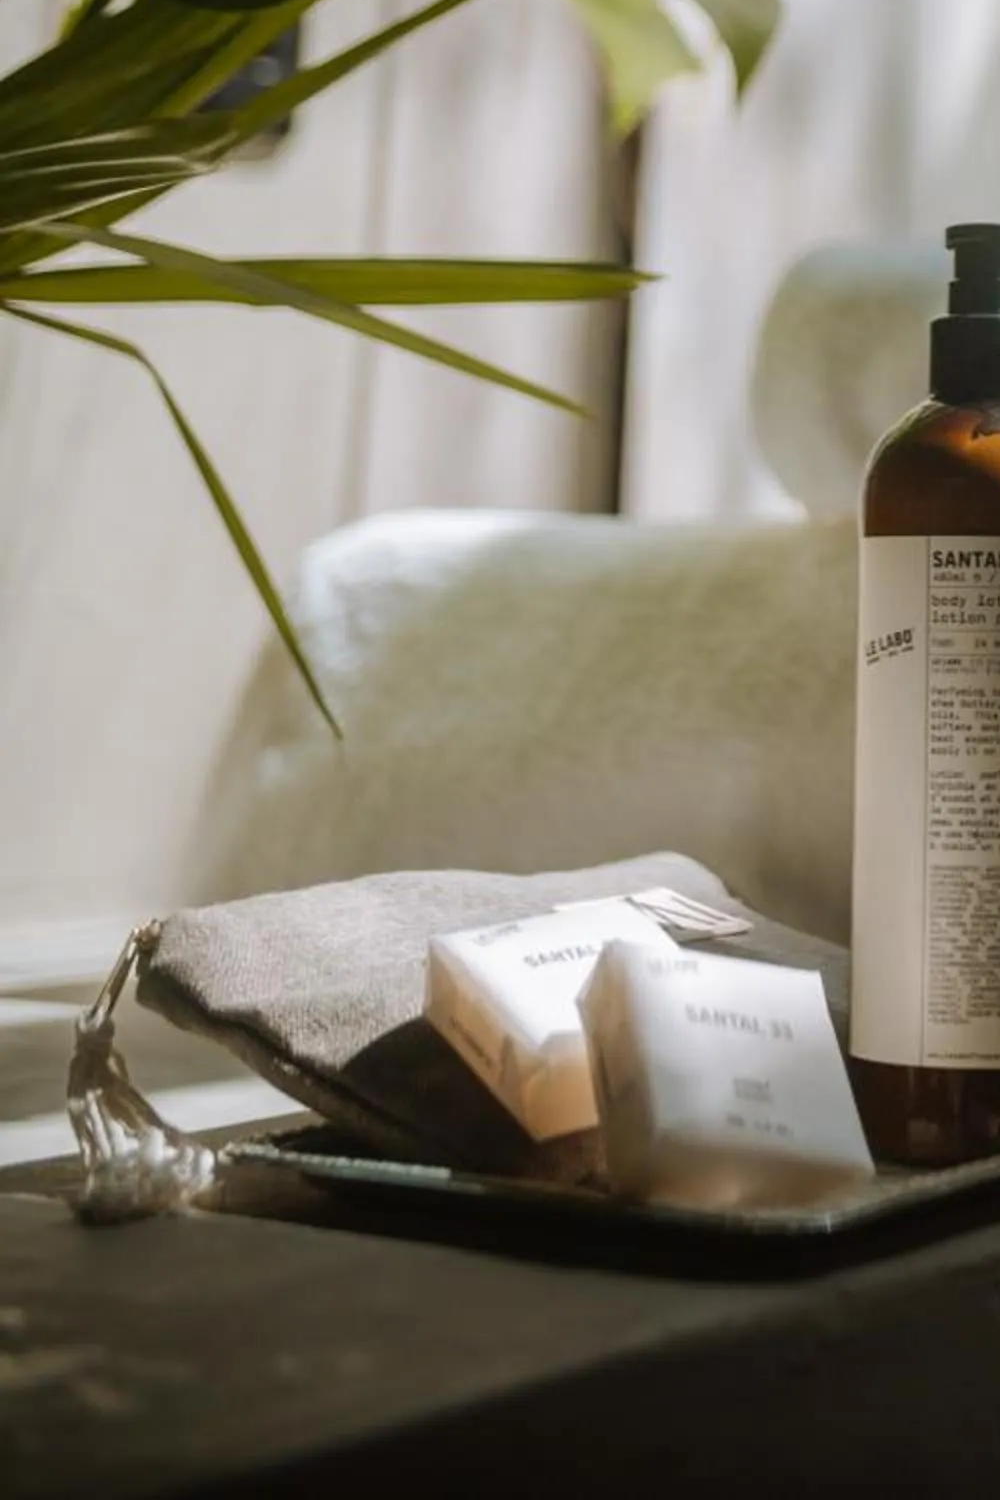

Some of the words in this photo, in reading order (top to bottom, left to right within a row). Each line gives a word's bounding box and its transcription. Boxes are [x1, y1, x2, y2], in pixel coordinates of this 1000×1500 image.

[931, 593, 967, 608] body
[931, 611, 987, 625] lotion
[878, 629, 913, 651] LABO
[685, 1004, 767, 1036] SANTAL
